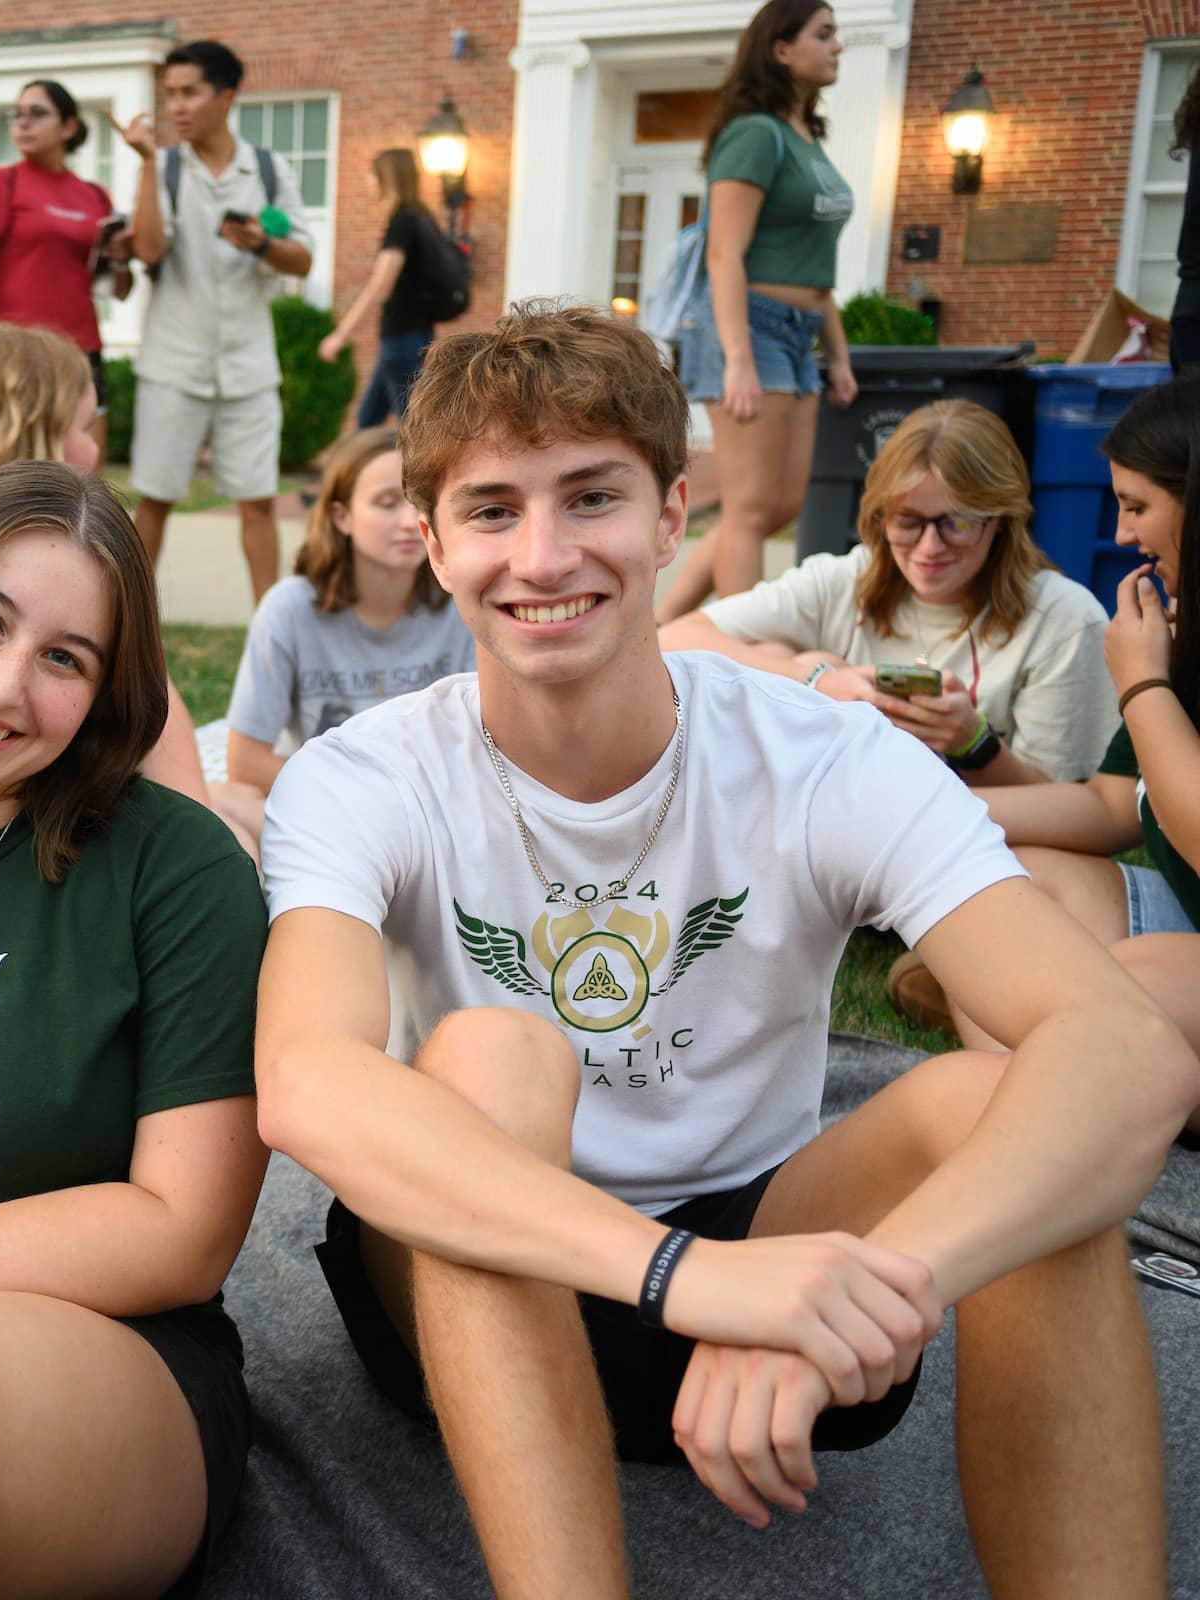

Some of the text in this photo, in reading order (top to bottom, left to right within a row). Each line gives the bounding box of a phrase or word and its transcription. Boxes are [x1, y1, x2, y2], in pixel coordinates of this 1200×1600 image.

[545, 880, 659, 903] 2024
[584, 1028, 694, 1068] LTIC
[592, 1059, 674, 1088] ASH
